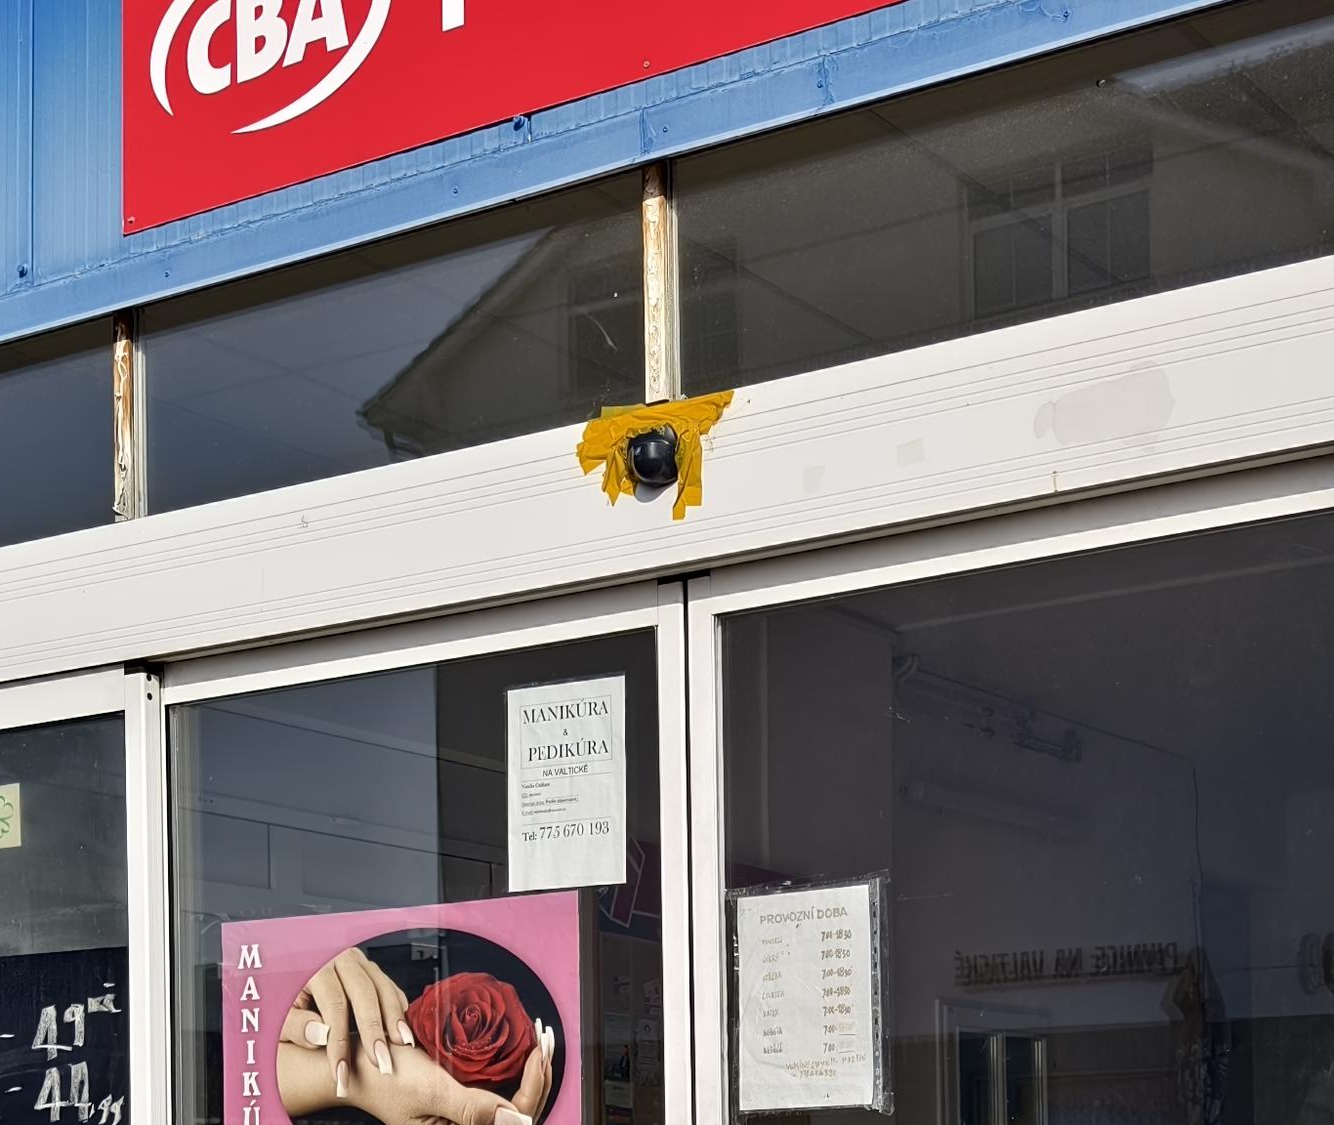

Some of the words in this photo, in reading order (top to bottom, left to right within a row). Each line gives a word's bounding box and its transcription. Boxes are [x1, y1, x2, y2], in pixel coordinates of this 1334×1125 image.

[185, 0, 350, 95] CBA
[523, 699, 609, 724] MANIKÚRA
[528, 738, 609, 762] PEDIKÚRA
[542, 768, 554, 777] NA
[555, 764, 589, 776] VALTICKÉ
[522, 831, 537, 842] Tel:
[563, 823, 584, 837] 670
[589, 821, 610, 835] 193
[760, 906, 815, 924] PROVOZNÍ
[816, 906, 848, 920] DOBA
